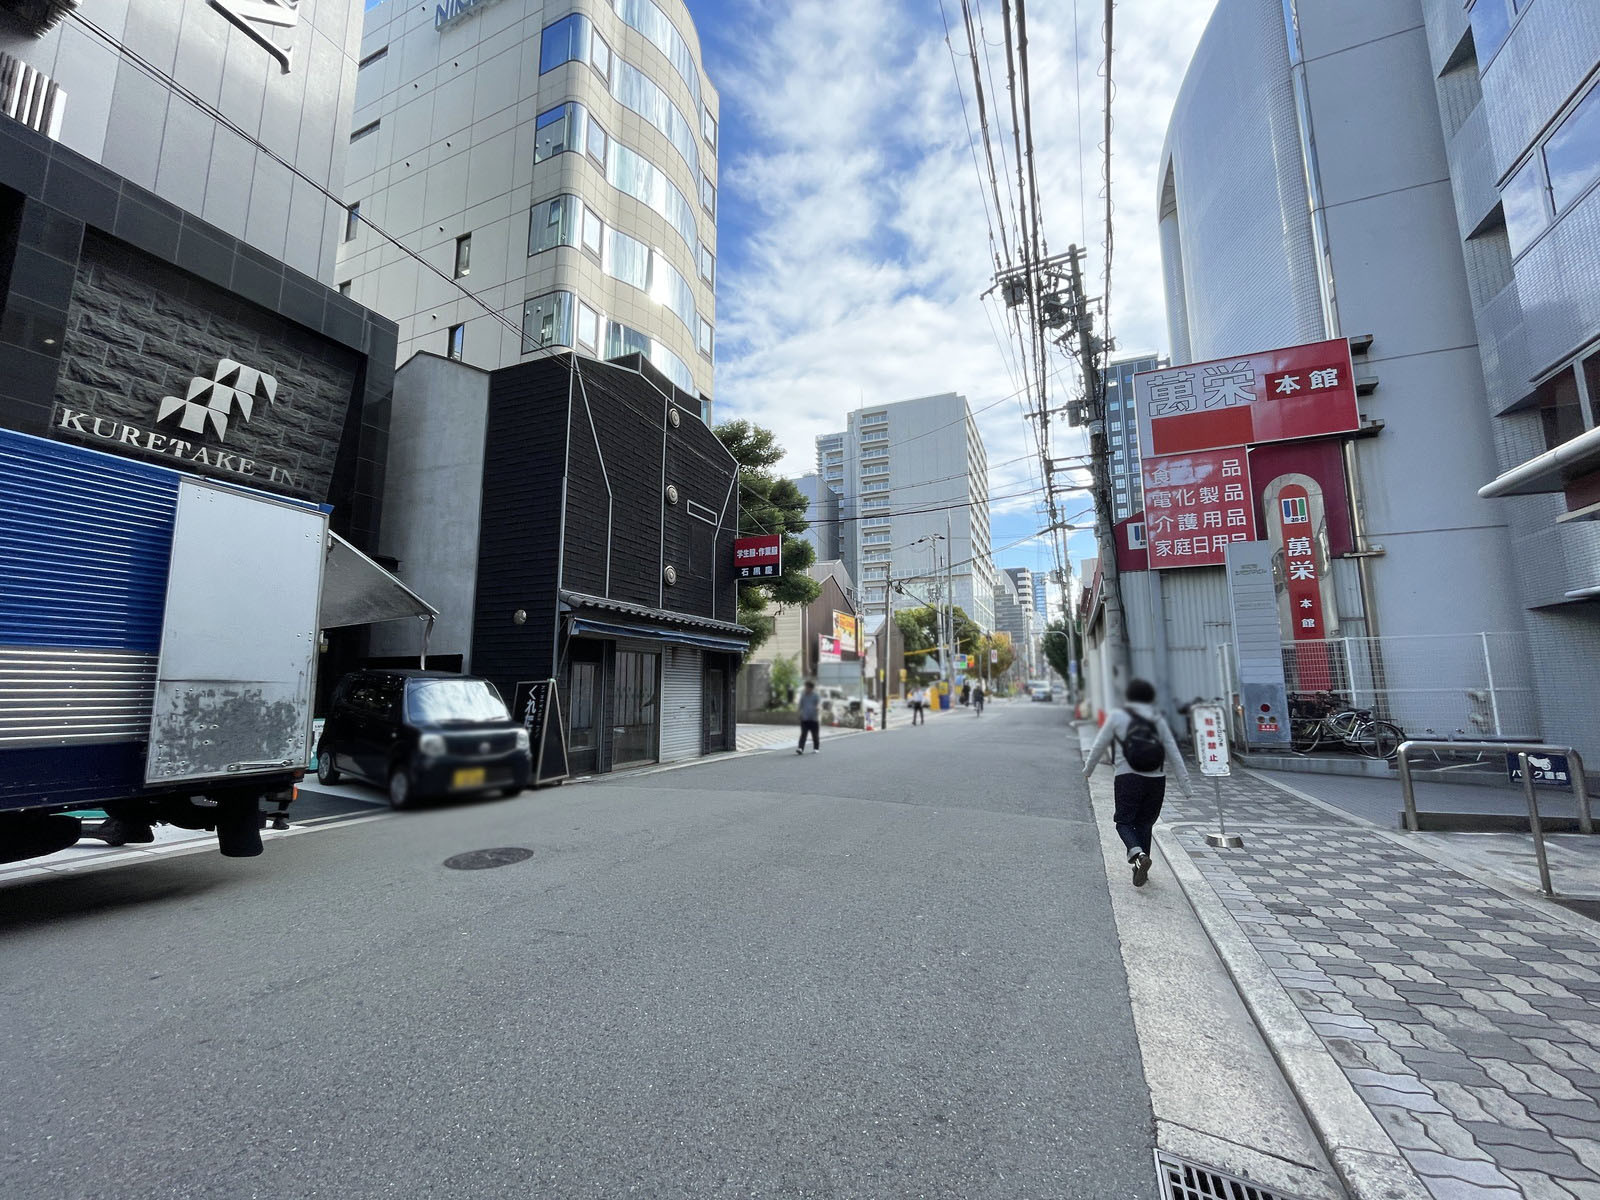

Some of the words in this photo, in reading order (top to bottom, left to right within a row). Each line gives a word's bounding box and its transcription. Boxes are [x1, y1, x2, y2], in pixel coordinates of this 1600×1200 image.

[1147, 361, 1257, 417] 萬栄
[1274, 368, 1338, 395] 本館
[58, 408, 256, 476] KURETAKE
[1152, 484, 1244, 508] 電化製品
[1155, 508, 1247, 533] 介護用品
[1287, 536, 1315, 580] 萬栄
[1300, 598, 1315, 628] 本館
[1511, 769, 1567, 780] バク置場
